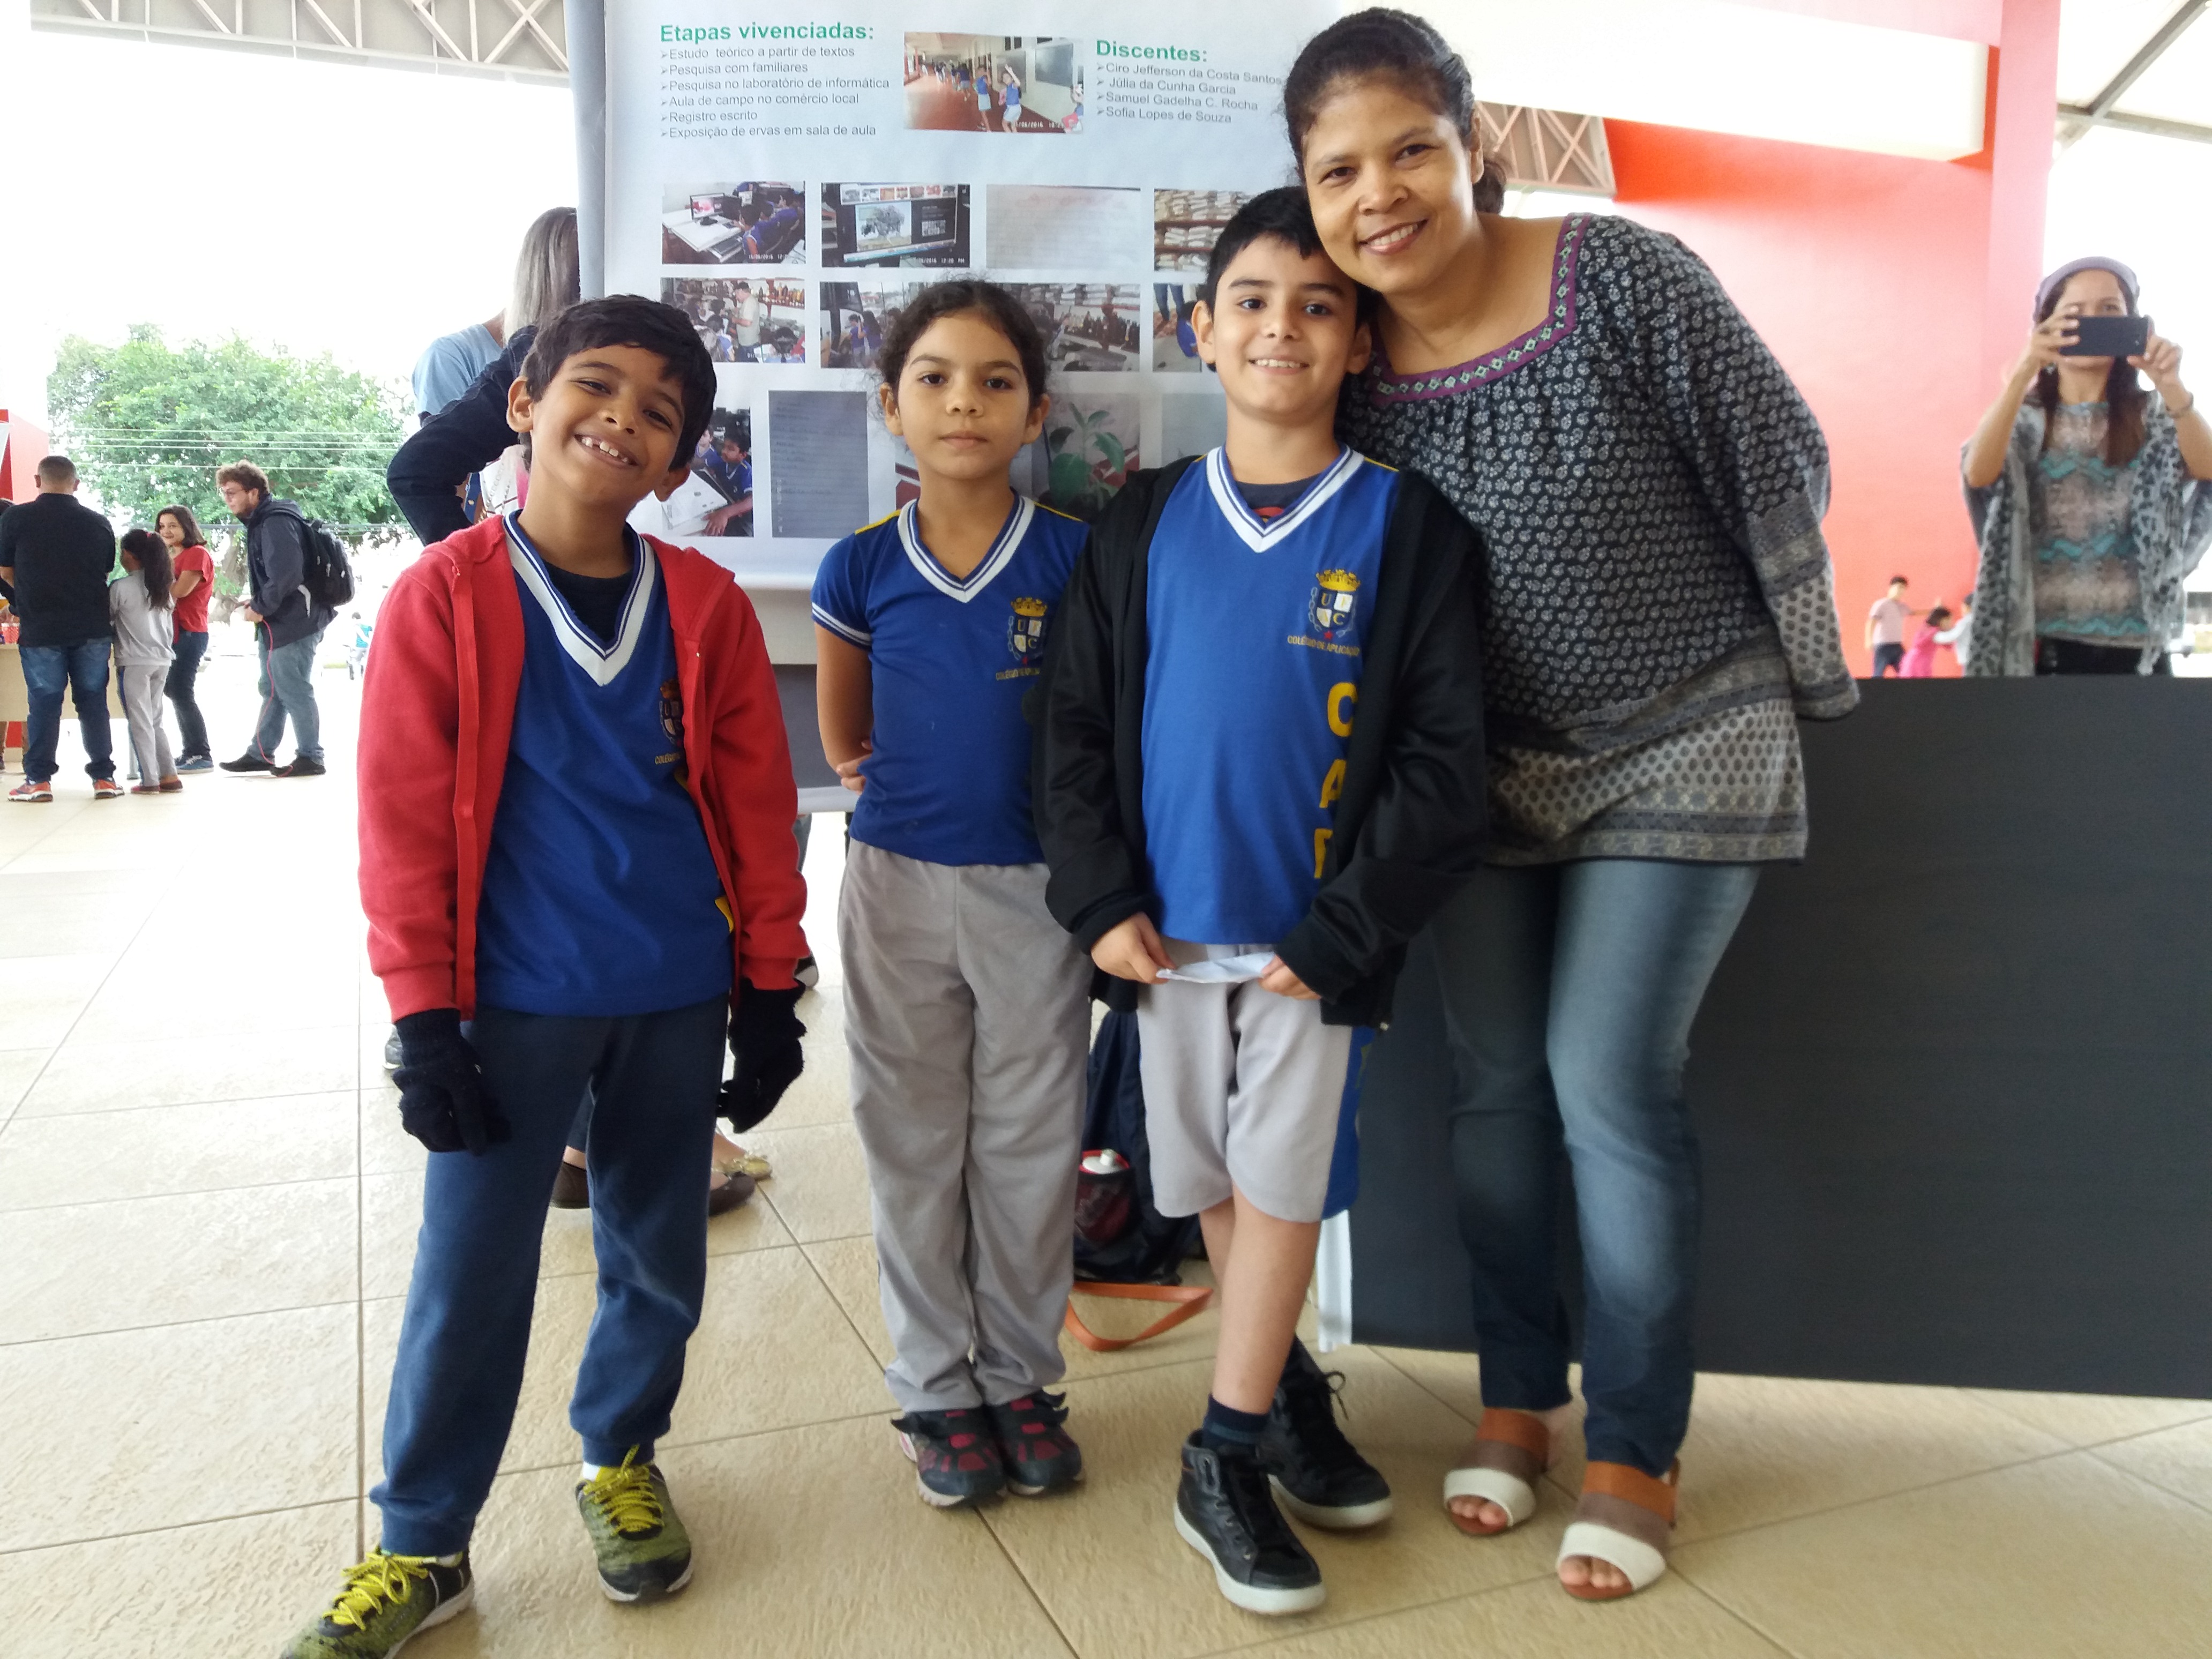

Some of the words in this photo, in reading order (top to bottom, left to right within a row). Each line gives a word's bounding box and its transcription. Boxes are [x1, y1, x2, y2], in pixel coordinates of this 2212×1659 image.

[661, 24, 731, 45] Etapas
[738, 21, 873, 40] vivenciadas:
[670, 48, 709, 59] Estudo
[716, 46, 754, 58] teórico
[758, 48, 765, 57] a
[768, 46, 798, 58] partir
[802, 46, 816, 57] de
[820, 46, 855, 57] textos
[1096, 39, 1207, 63] Discentes:
[670, 63, 721, 77] Pesquisa
[725, 63, 749, 73] com
[753, 61, 809, 73] familiares
[1105, 62, 1130, 74] Ciro
[1133, 64, 1185, 77] Jefferson
[1189, 68, 1204, 79] da
[1206, 69, 1240, 81] Costa
[1243, 71, 1282, 85] Santos
[670, 79, 721, 92] Pesquisa
[725, 80, 739, 89] no
[743, 78, 804, 89] laboratório
[808, 78, 822, 88] de
[826, 77, 890, 88] informática
[1109, 77, 1136, 89] Júlia
[1139, 79, 1154, 91] da
[1157, 79, 1195, 93] Cunha
[1198, 81, 1236, 95] Garcia
[669, 96, 694, 107] Aula
[698, 95, 712, 106] de
[715, 95, 754, 107] campo
[758, 95, 772, 104] no
[775, 93, 829, 104] comércio
[832, 92, 859, 104] local
[1105, 91, 1150, 104] Samuel
[1153, 93, 1202, 108] Gadelha
[1221, 98, 1259, 111] Rocha
[670, 111, 716, 124] Registro
[720, 110, 758, 121] escrito
[1105, 106, 1135, 119] Sofia
[1138, 108, 1174, 122] Lopes
[1177, 109, 1192, 121] de
[1195, 110, 1232, 123] Souza
[670, 126, 728, 139] Exposição
[731, 125, 746, 136] de
[749, 125, 781, 136] ervas
[784, 125, 803, 135] em
[806, 124, 830, 135] sala
[833, 124, 848, 135] de
[851, 124, 877, 135] aula
